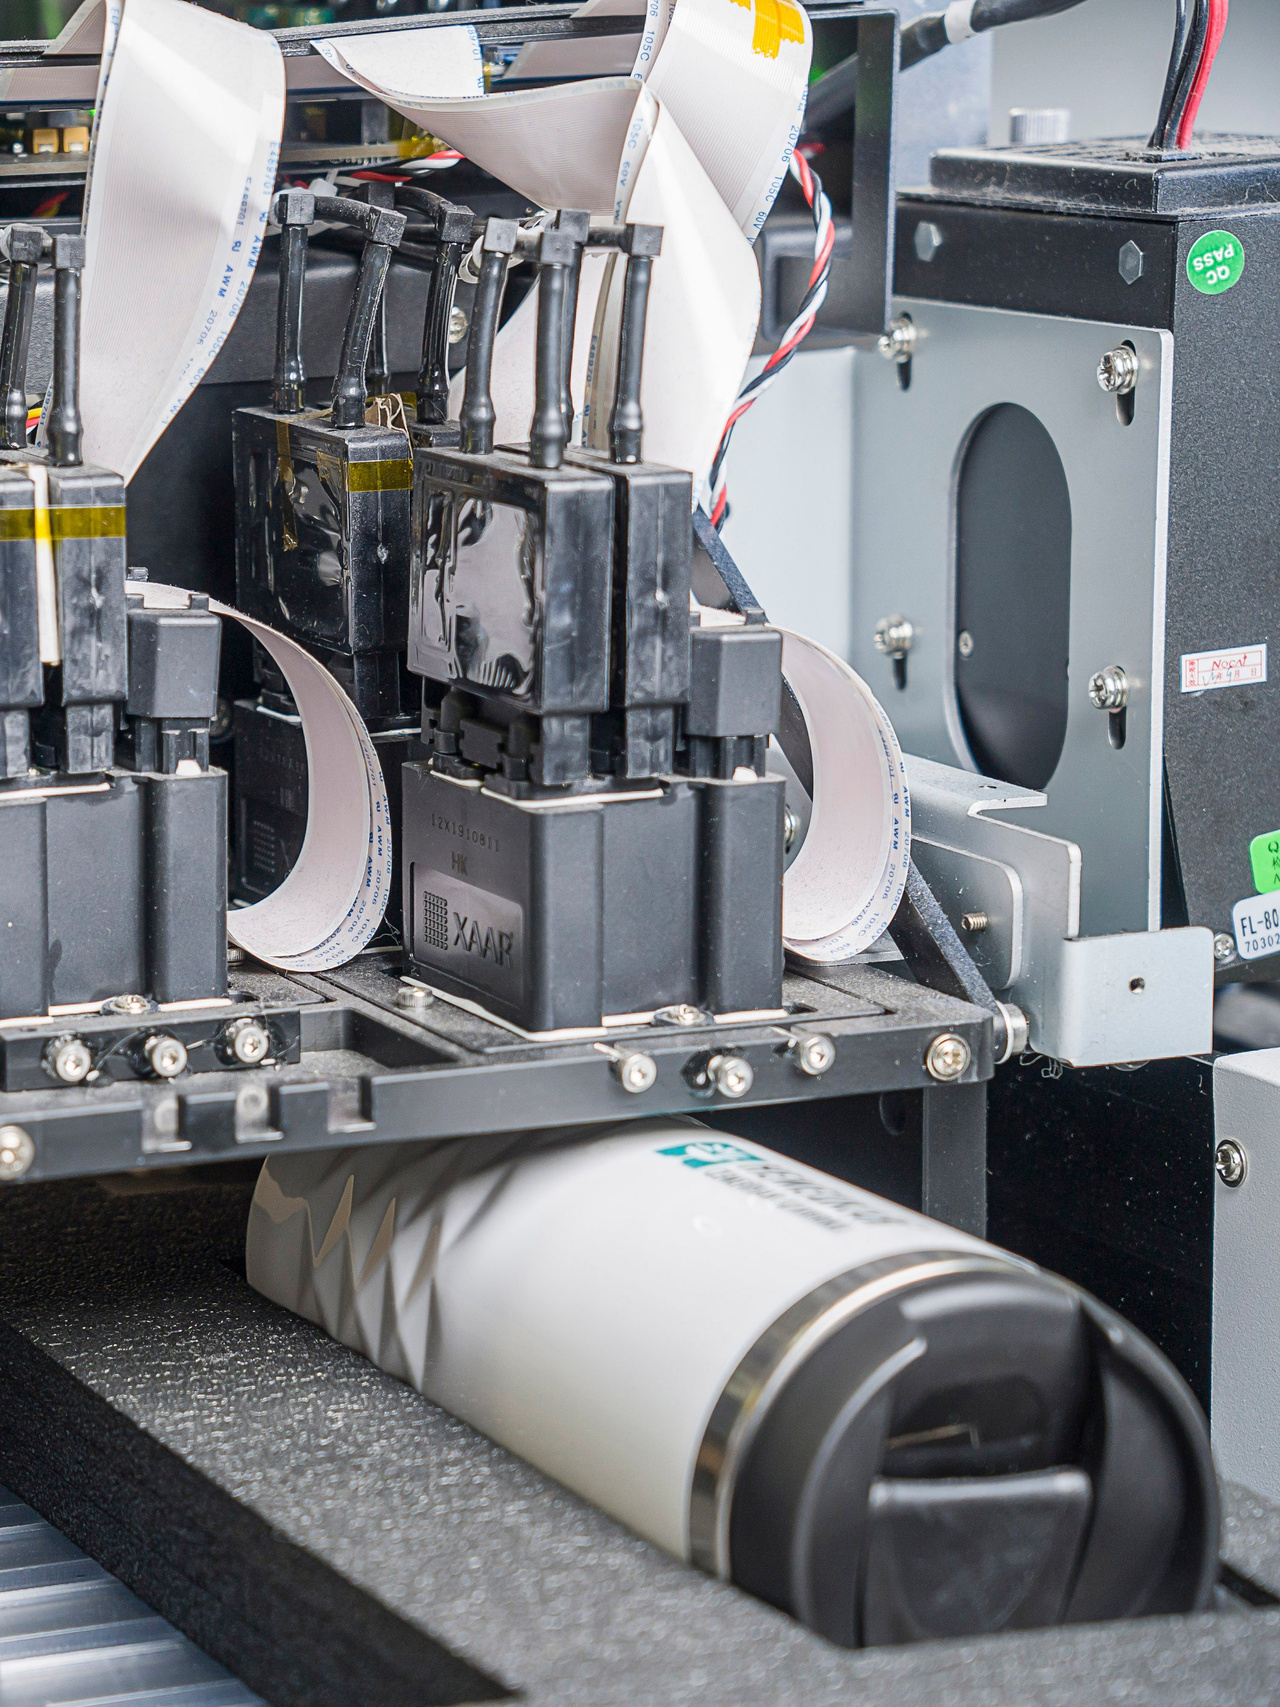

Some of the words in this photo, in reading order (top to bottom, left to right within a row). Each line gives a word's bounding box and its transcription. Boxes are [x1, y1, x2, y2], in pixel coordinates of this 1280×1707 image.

[640, 30, 656, 61] 105C
[782, 125, 799, 163] 20706
[766, 176, 783, 202] 105C
[753, 211, 767, 230] 60V
[247, 235, 263, 268] AWM
[1193, 243, 1234, 272] PASS
[218, 264, 233, 297] AWM
[1206, 265, 1230, 285] QC
[228, 280, 249, 318] 20706
[196, 310, 217, 345] 20706
[431, 813, 500, 853] 12X1910811
[365, 856, 373, 888] AWM
[451, 851, 469, 876] HK
[372, 869, 382, 905] 20706
[882, 863, 896, 900] 20706
[347, 899, 367, 934] 20706
[352, 918, 370, 943] 105C
[858, 912, 879, 937] 105C
[453, 911, 513, 970] XAAR
